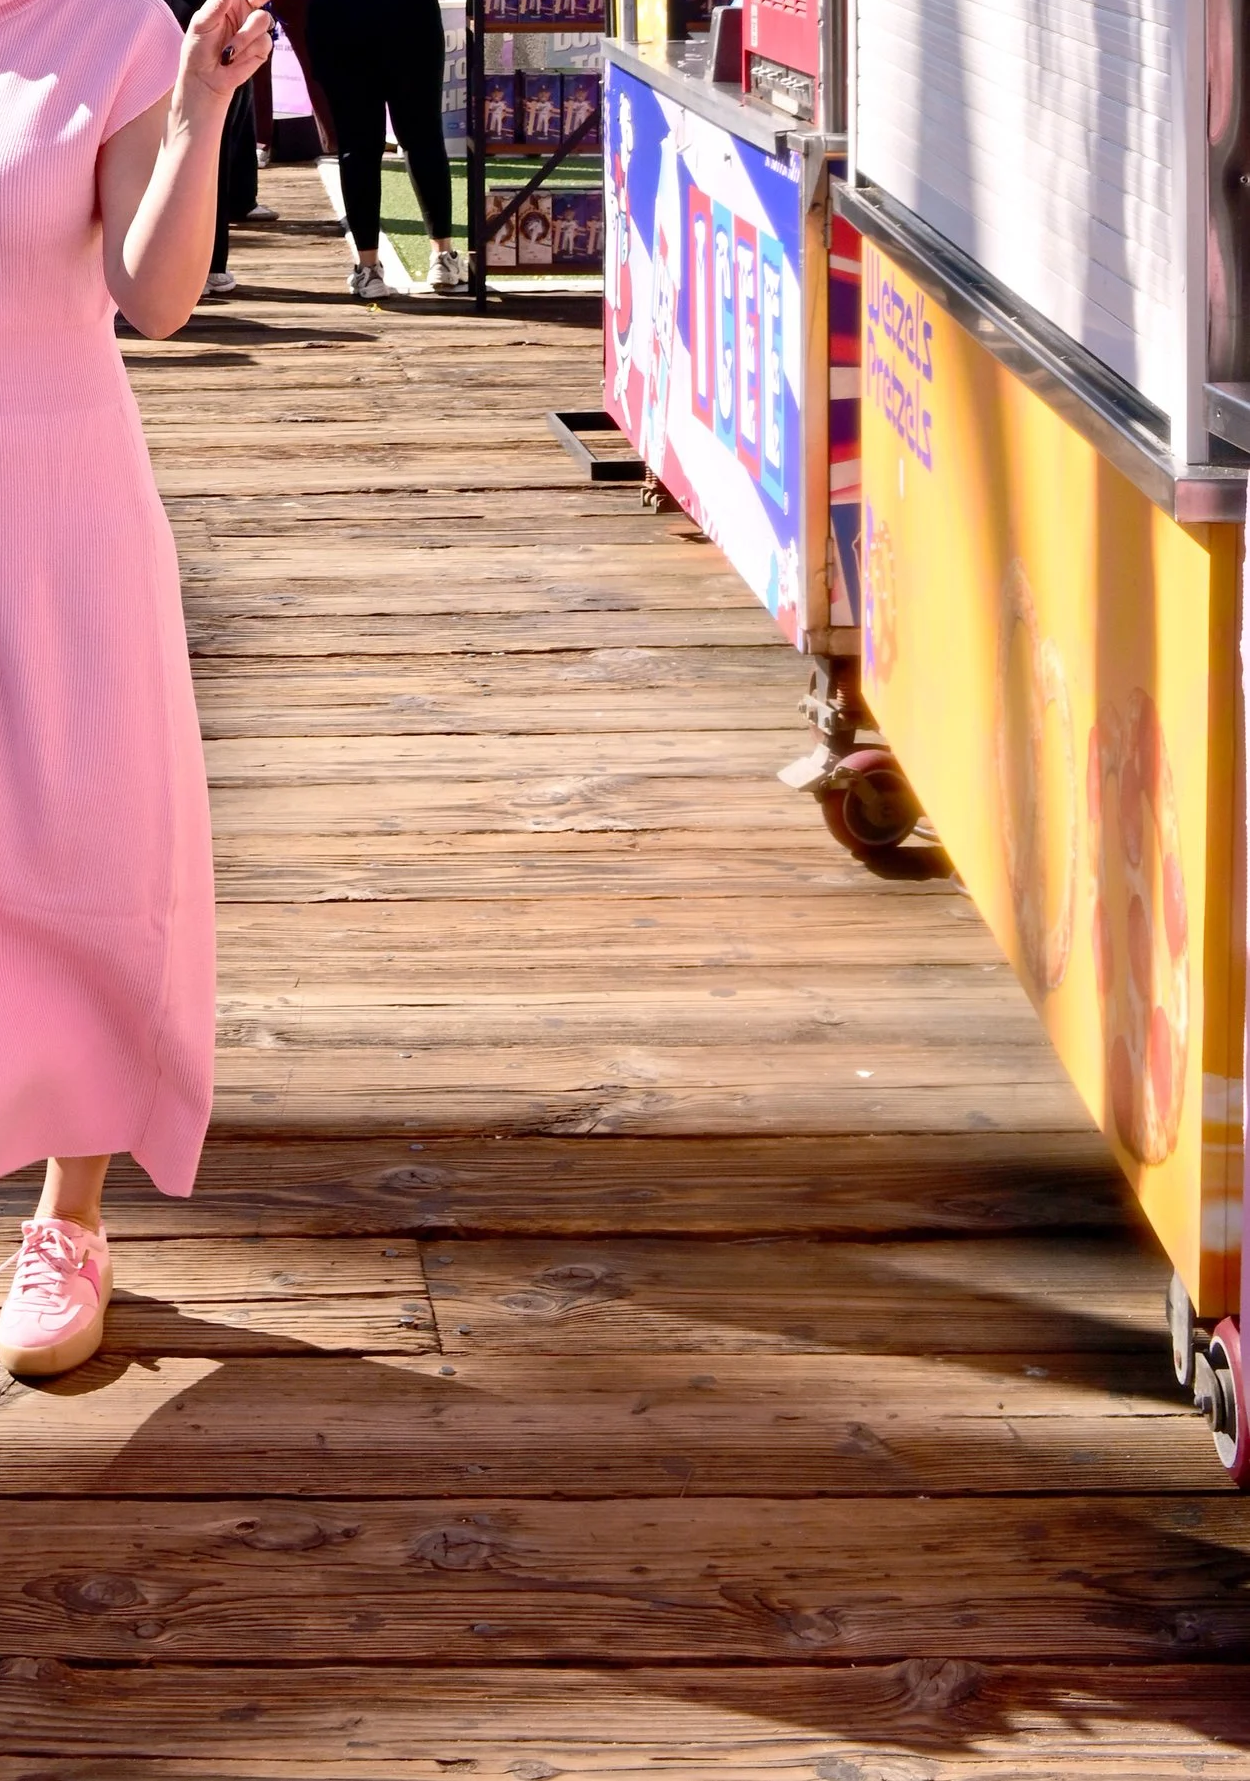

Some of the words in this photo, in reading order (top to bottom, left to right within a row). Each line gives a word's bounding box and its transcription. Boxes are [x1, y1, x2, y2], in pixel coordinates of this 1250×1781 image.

[691, 212, 782, 472] ICEE
[866, 244, 933, 384] Wetzel's
[866, 323, 933, 474] Pretzels
